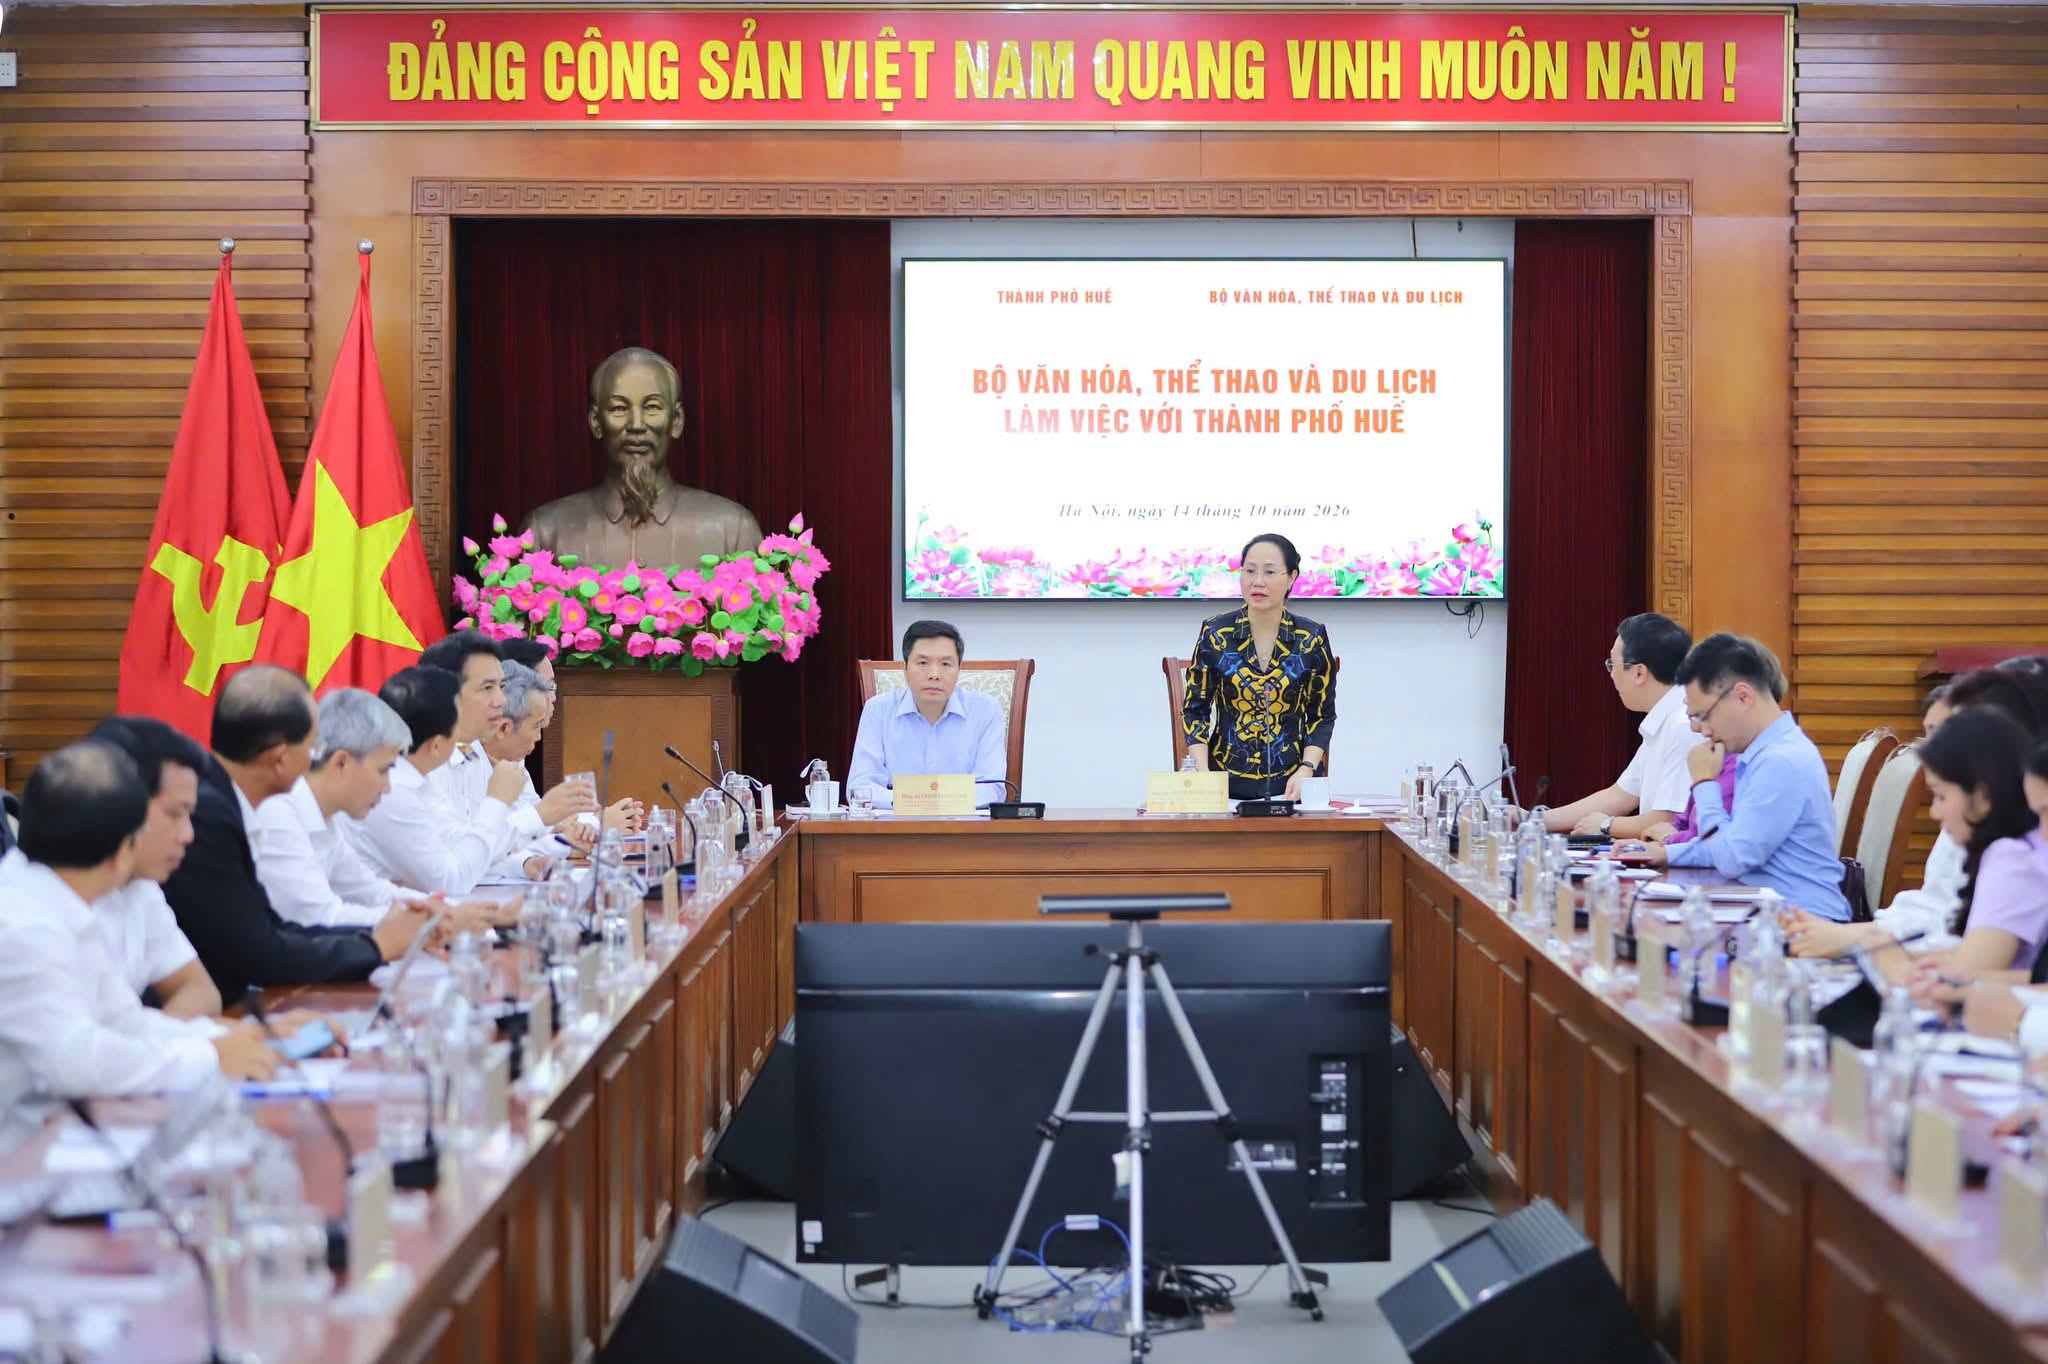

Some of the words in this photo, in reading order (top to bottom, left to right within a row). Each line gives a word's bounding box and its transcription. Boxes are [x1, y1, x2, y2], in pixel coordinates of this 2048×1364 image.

[387, 19, 526, 102] ĐẢNG
[544, 26, 680, 115] CỘNG
[698, 18, 804, 101] SẢN
[821, 26, 937, 112] VIỆT
[954, 39, 1076, 101] NAM
[1093, 38, 1265, 106] QUANG
[1286, 39, 1401, 100] VINH
[1419, 26, 1568, 101] MUÔN
[1586, 26, 1704, 101] NĂM
[1723, 41, 1737, 102] !
[1340, 290, 1376, 304] THAO
[1406, 290, 1425, 304] DU
[972, 363, 1007, 400] BỘ
[1017, 364, 1071, 395] VĂN
[1080, 363, 1142, 397] HÓA,
[1152, 358, 1203, 395] THỂ
[1210, 368, 1279, 395] THAO
[1288, 363, 1322, 395] VÀ
[1332, 368, 1367, 395] DU
[1377, 368, 1437, 400] LỊCH
[1004, 403, 1059, 433] LÀM
[1070, 403, 1129, 439] VIỆC
[1139, 401, 1183, 434] VỚI
[1193, 403, 1281, 434] THÀNH
[1290, 399, 1344, 434] PHỐ
[1353, 399, 1406, 434] HUẾ
[1173, 504, 1191, 517] 14
[1249, 503, 1268, 517] 10
[1312, 503, 1351, 517] 2026
